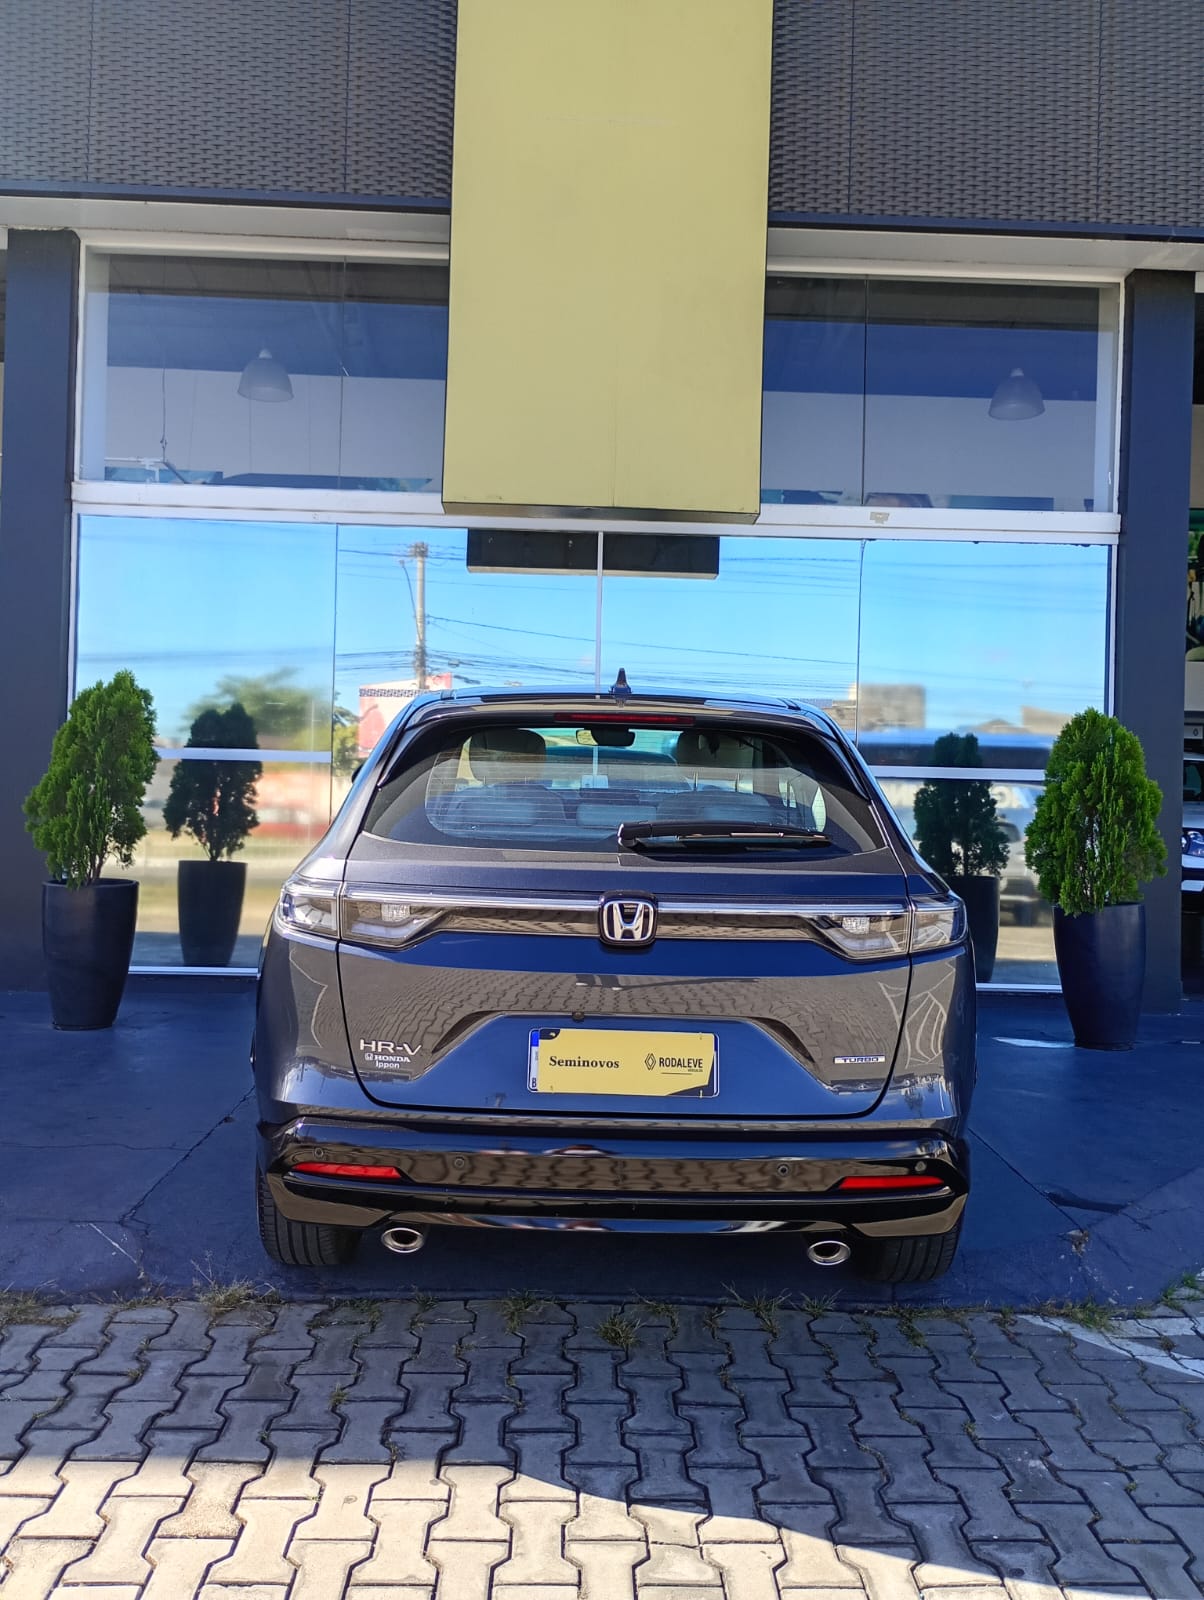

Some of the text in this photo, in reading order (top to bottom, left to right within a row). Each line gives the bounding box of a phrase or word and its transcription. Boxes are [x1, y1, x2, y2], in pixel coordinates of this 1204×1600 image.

[359, 1039, 422, 1056] HR-V
[374, 1055, 411, 1063] HONDA
[549, 1055, 620, 1069] Seminovos
[659, 1057, 703, 1068] RODALEVE
[375, 1061, 400, 1069] Ippon
